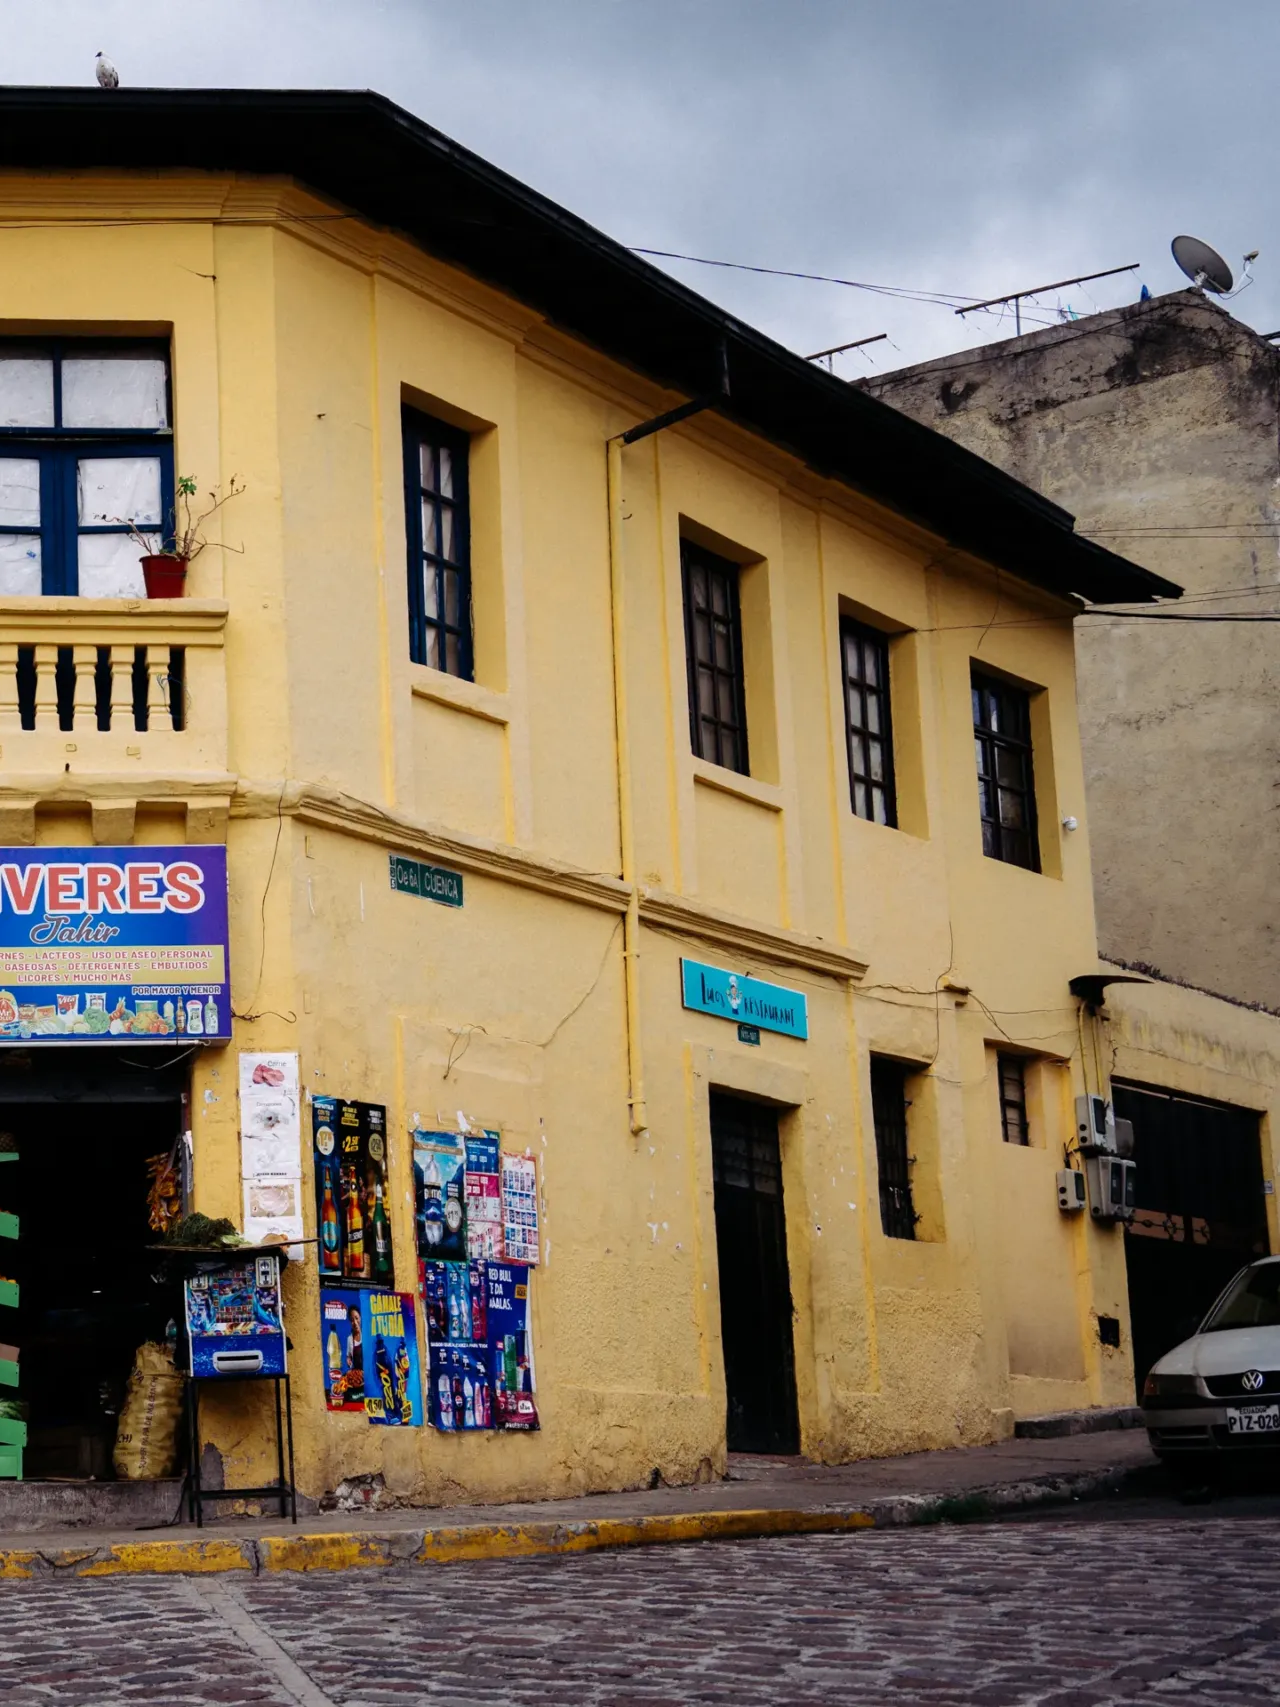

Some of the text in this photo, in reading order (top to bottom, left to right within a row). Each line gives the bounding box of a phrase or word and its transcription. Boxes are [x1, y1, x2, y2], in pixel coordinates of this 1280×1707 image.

[425, 872, 459, 899] CUENCA
[30, 914, 120, 944] Jahir
[92, 951, 112, 959] USO
[115, 951, 128, 959] DE
[131, 951, 157, 959] ASEO
[160, 950, 213, 958] PERSONAL
[5, 963, 58, 971] GASEOSAS
[68, 962, 140, 970] DETERGENTES
[151, 961, 208, 970] EMBUTIDOS
[18, 974, 60, 983] LICORES
[64, 974, 69, 982] Y
[73, 974, 108, 982] MUCHO
[132, 985, 221, 995] POR MAYOR Y MENOR
[744, 997, 795, 1028] RESTAURANT
[488, 1268, 498, 1280] RED
[499, 1269, 512, 1282] BULL
[495, 1283, 503, 1295] DA
[370, 1292, 401, 1314] GÁNALE
[377, 1316, 388, 1336] TU
[388, 1313, 404, 1337] DÍA
[144, 1416, 153, 1426] DE
[141, 1427, 151, 1446] PAPA
[138, 1447, 148, 1469] SUPER
